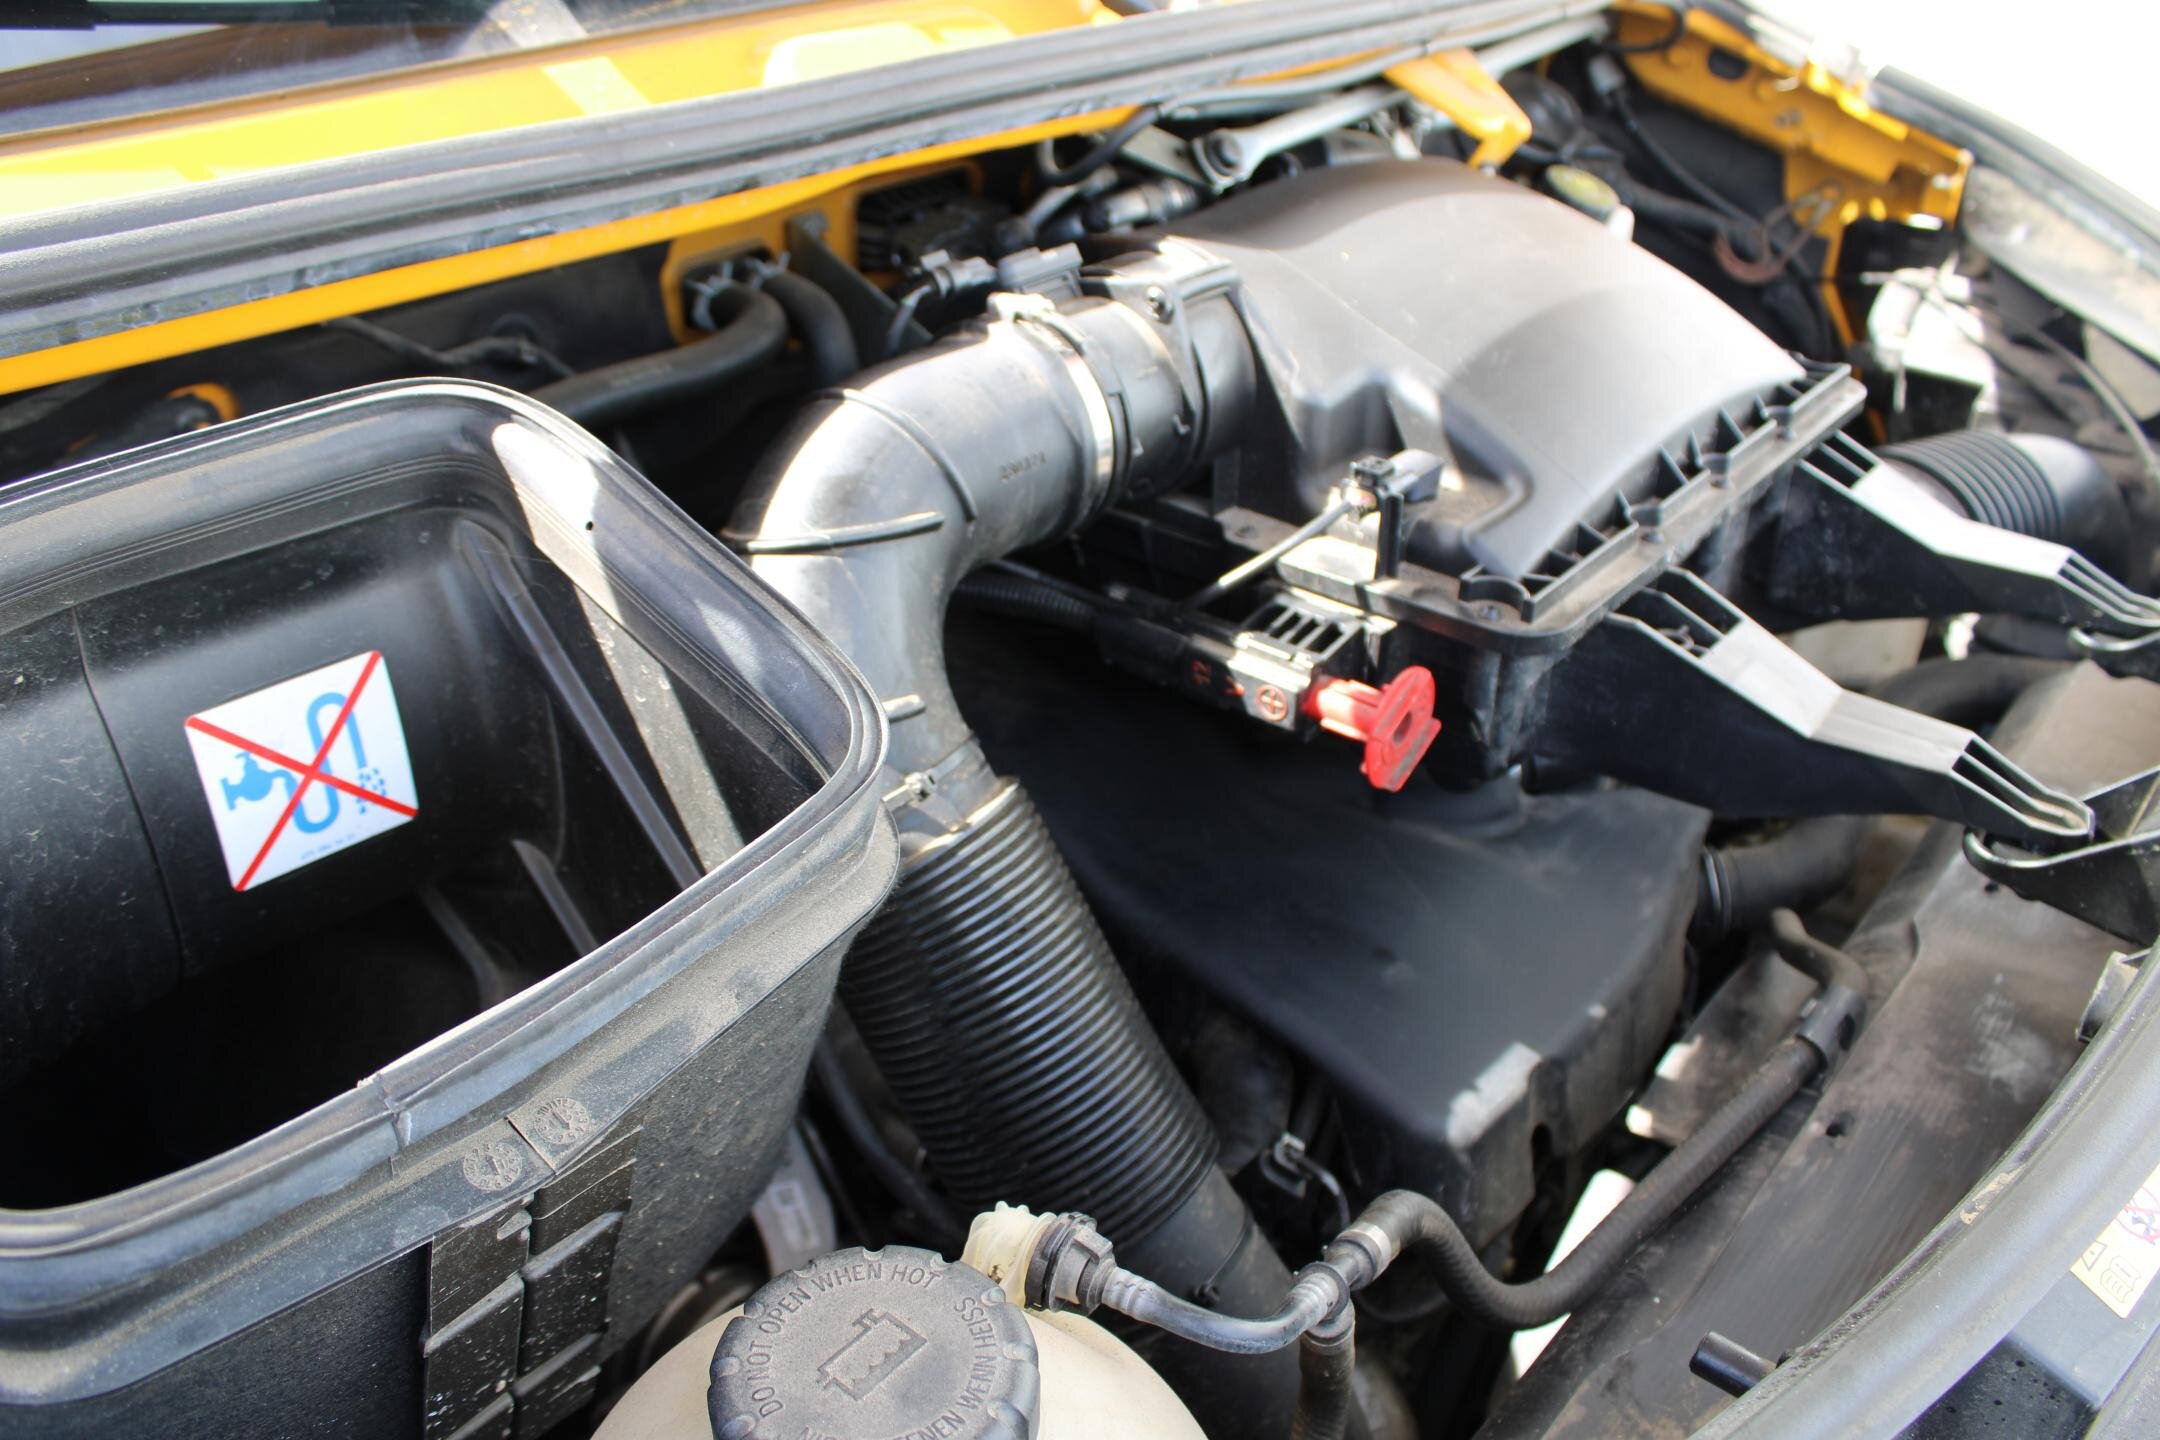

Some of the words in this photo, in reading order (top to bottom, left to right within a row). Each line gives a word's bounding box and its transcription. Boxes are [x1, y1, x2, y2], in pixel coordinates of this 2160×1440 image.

[810, 1262, 882, 1292] WHEN
[891, 1263, 941, 1289] HOT
[758, 1287, 812, 1334] OPEN
[953, 1296, 997, 1349] HEISS
[746, 1340, 773, 1381] NOT
[751, 1386, 784, 1418] DO
[955, 1355, 998, 1410] WENN
